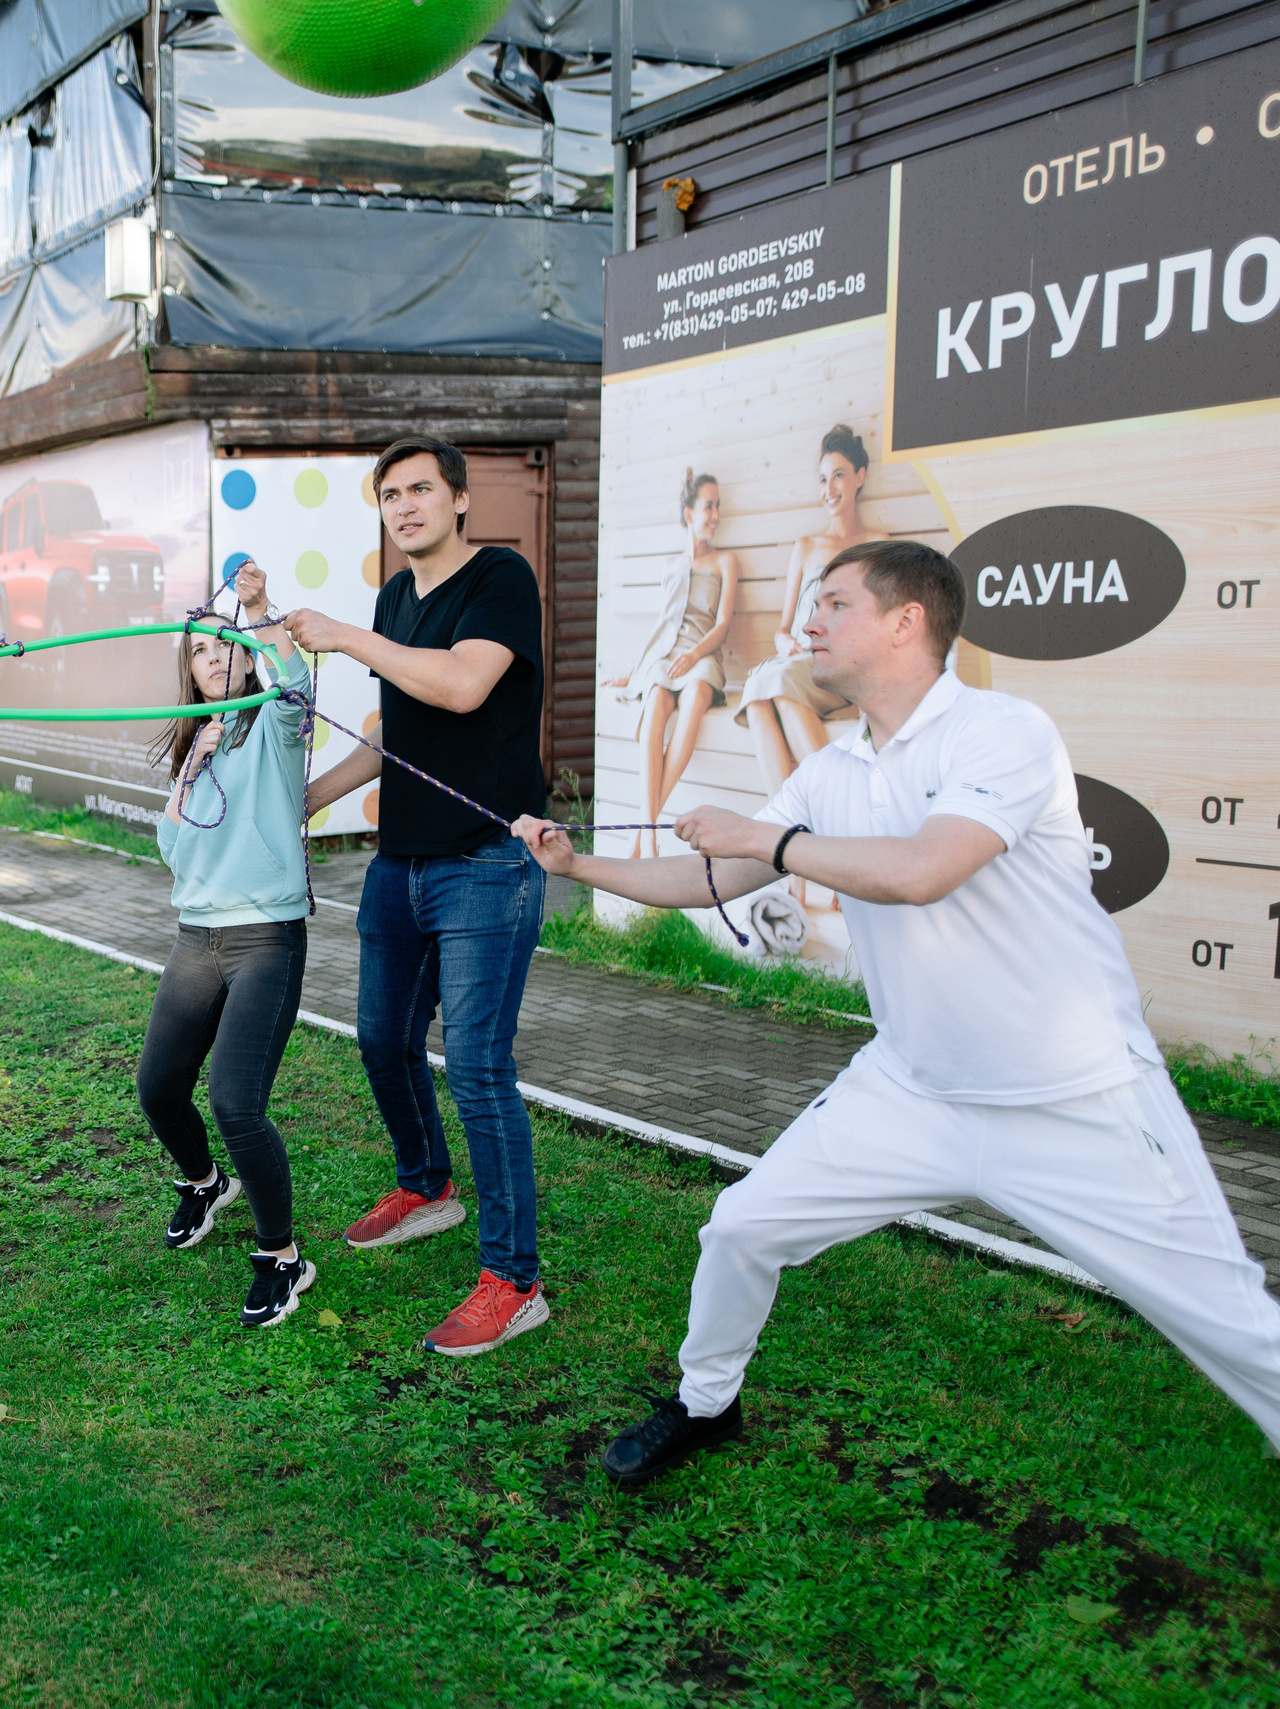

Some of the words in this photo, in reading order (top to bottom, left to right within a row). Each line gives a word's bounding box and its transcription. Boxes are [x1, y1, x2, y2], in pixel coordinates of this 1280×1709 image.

[1023, 132, 1166, 205] ОТЕЛЬ
[657, 259, 715, 293] MARTON
[718, 226, 825, 276] GORDEEVSKIY
[622, 331, 651, 350] тел.:
[781, 272, 867, 311] 429-05-08
[663, 301, 683, 320] ул.
[685, 272, 781, 311] Гордеевская,
[936, 236, 1280, 380] КРУГЛО
[976, 558, 1129, 608] САУНА
